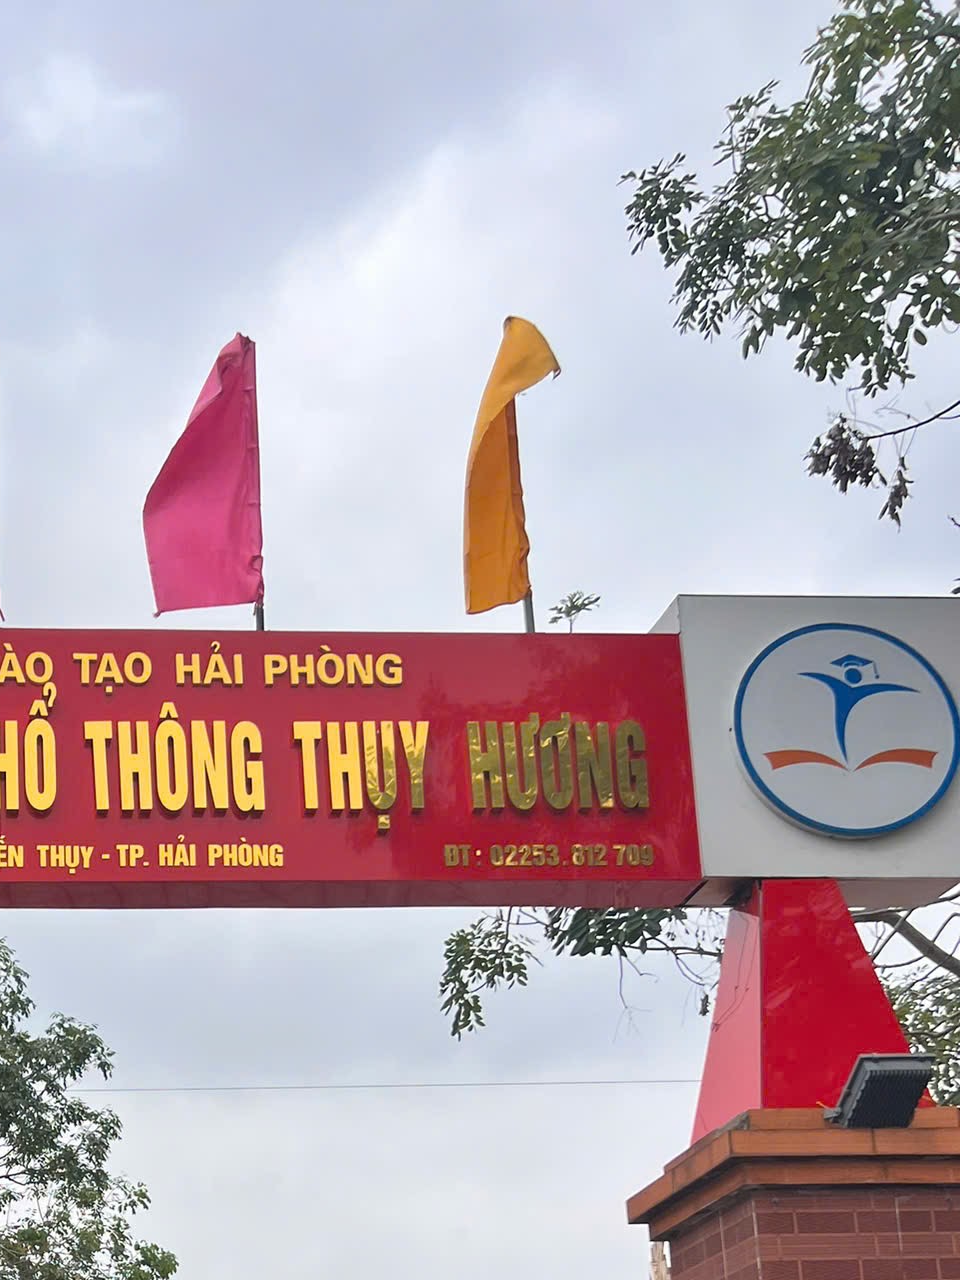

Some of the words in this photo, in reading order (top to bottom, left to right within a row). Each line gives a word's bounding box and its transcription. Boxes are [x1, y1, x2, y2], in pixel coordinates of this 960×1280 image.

[73, 652, 151, 692] TẠO
[176, 641, 243, 683] HẢI
[265, 645, 402, 684] PHÒNG
[85, 702, 265, 811] THÔNG
[293, 720, 430, 830] THỤY
[466, 712, 650, 811] HƯƠNG
[37, 845, 93, 873] THỤY
[117, 845, 149, 866] TP.
[159, 835, 196, 866] HẢI
[209, 838, 283, 866] PHÒNG
